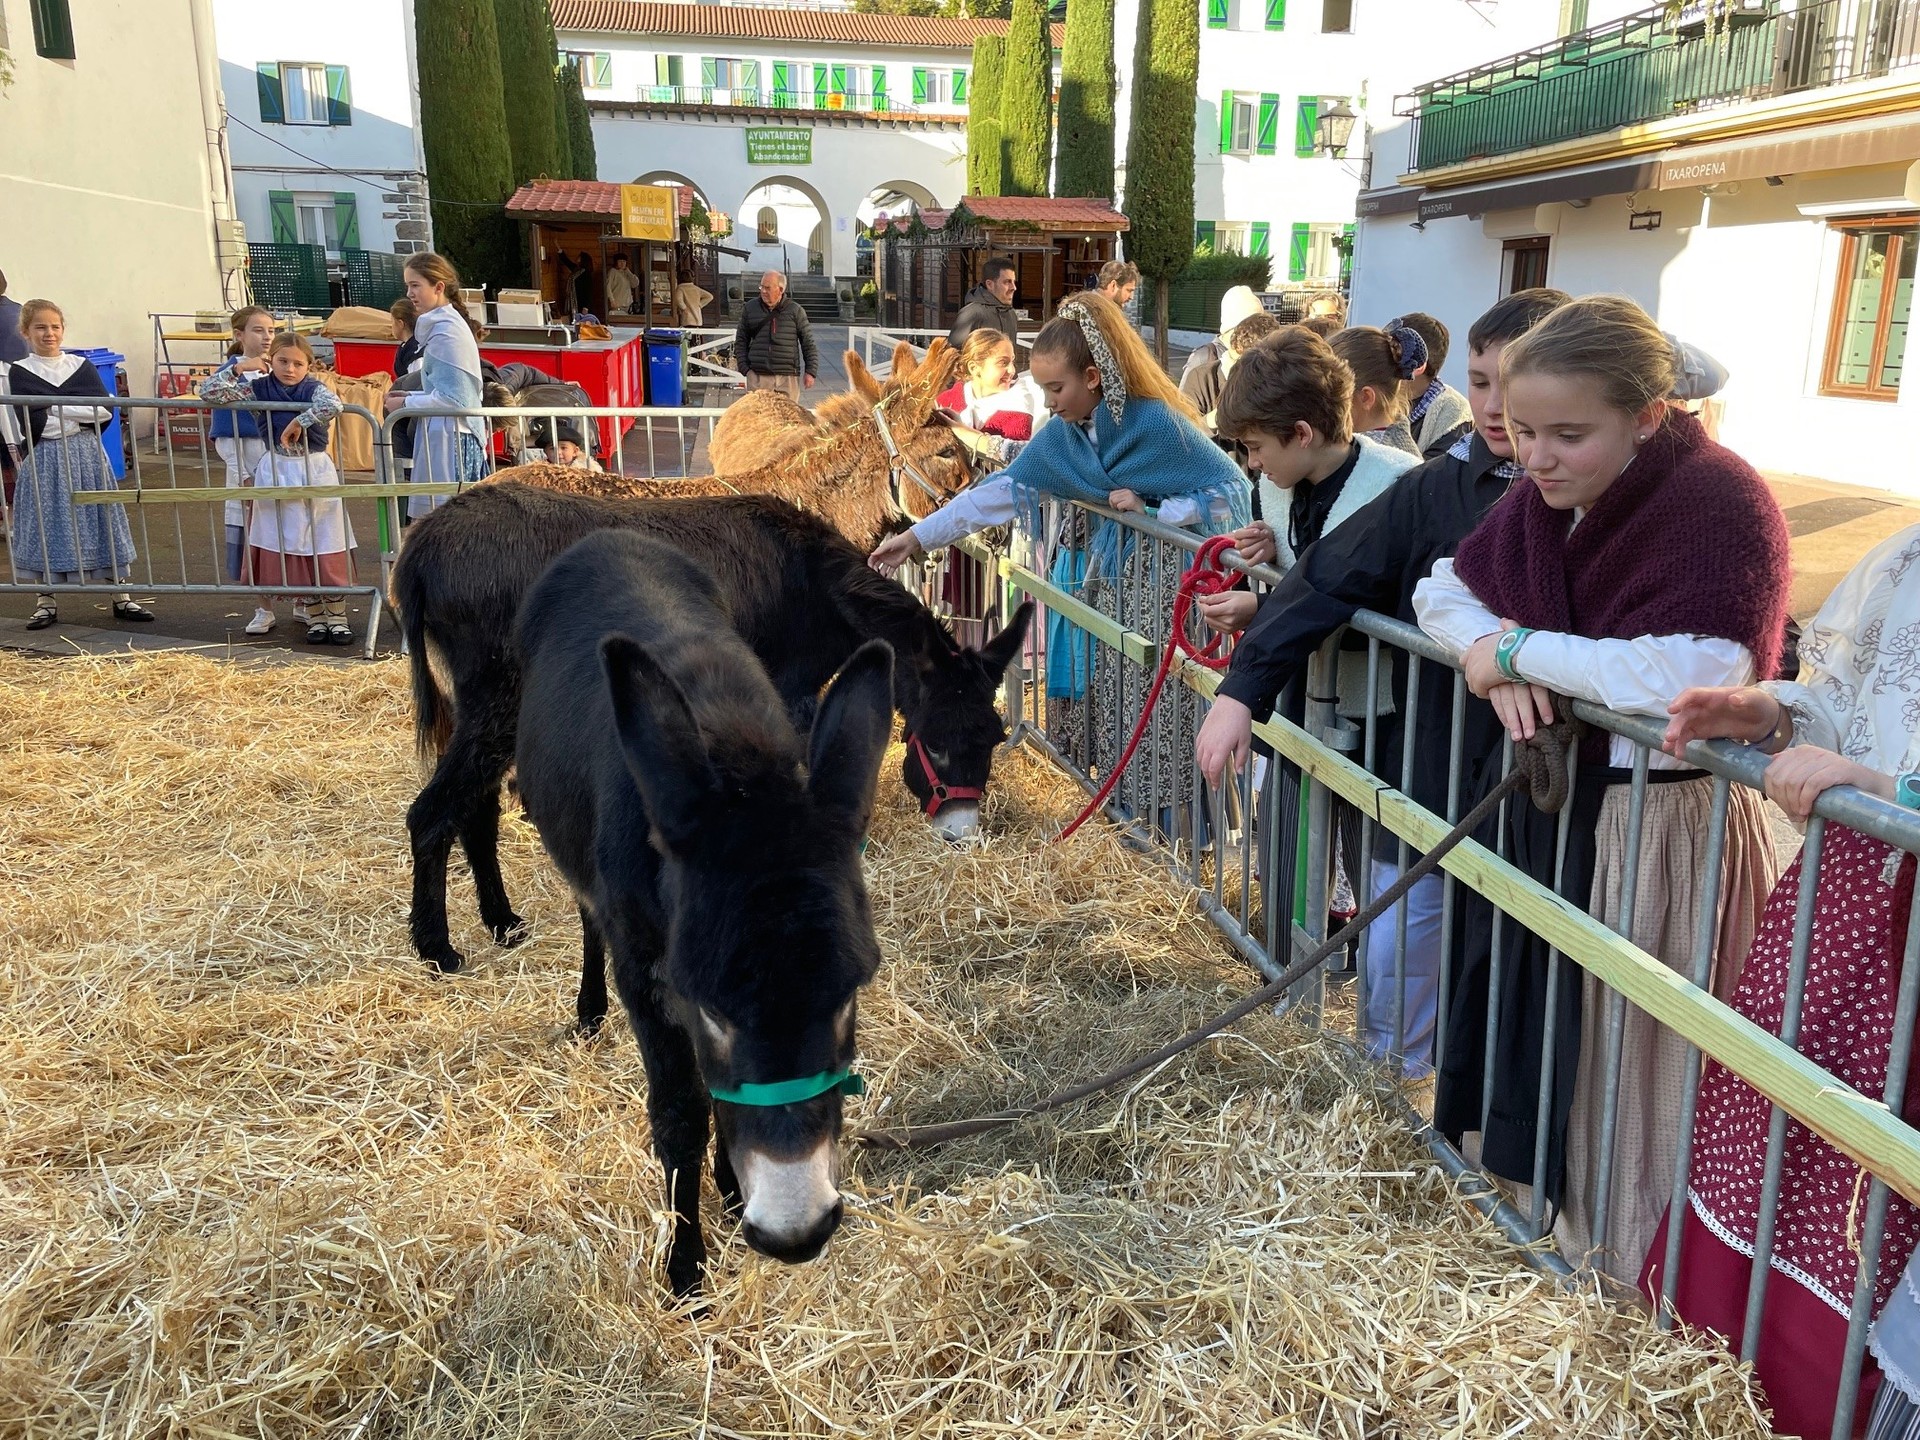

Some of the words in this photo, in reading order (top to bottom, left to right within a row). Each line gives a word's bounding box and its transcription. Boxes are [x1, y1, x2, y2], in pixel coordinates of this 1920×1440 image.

[748, 131, 811, 140] AYUNTAMIENTO
[750, 143, 776, 151] Tienes
[777, 142, 785, 150] el
[786, 143, 809, 151] barrio
[1666, 161, 1726, 181] ITXAROPENA
[653, 208, 665, 217] ERE
